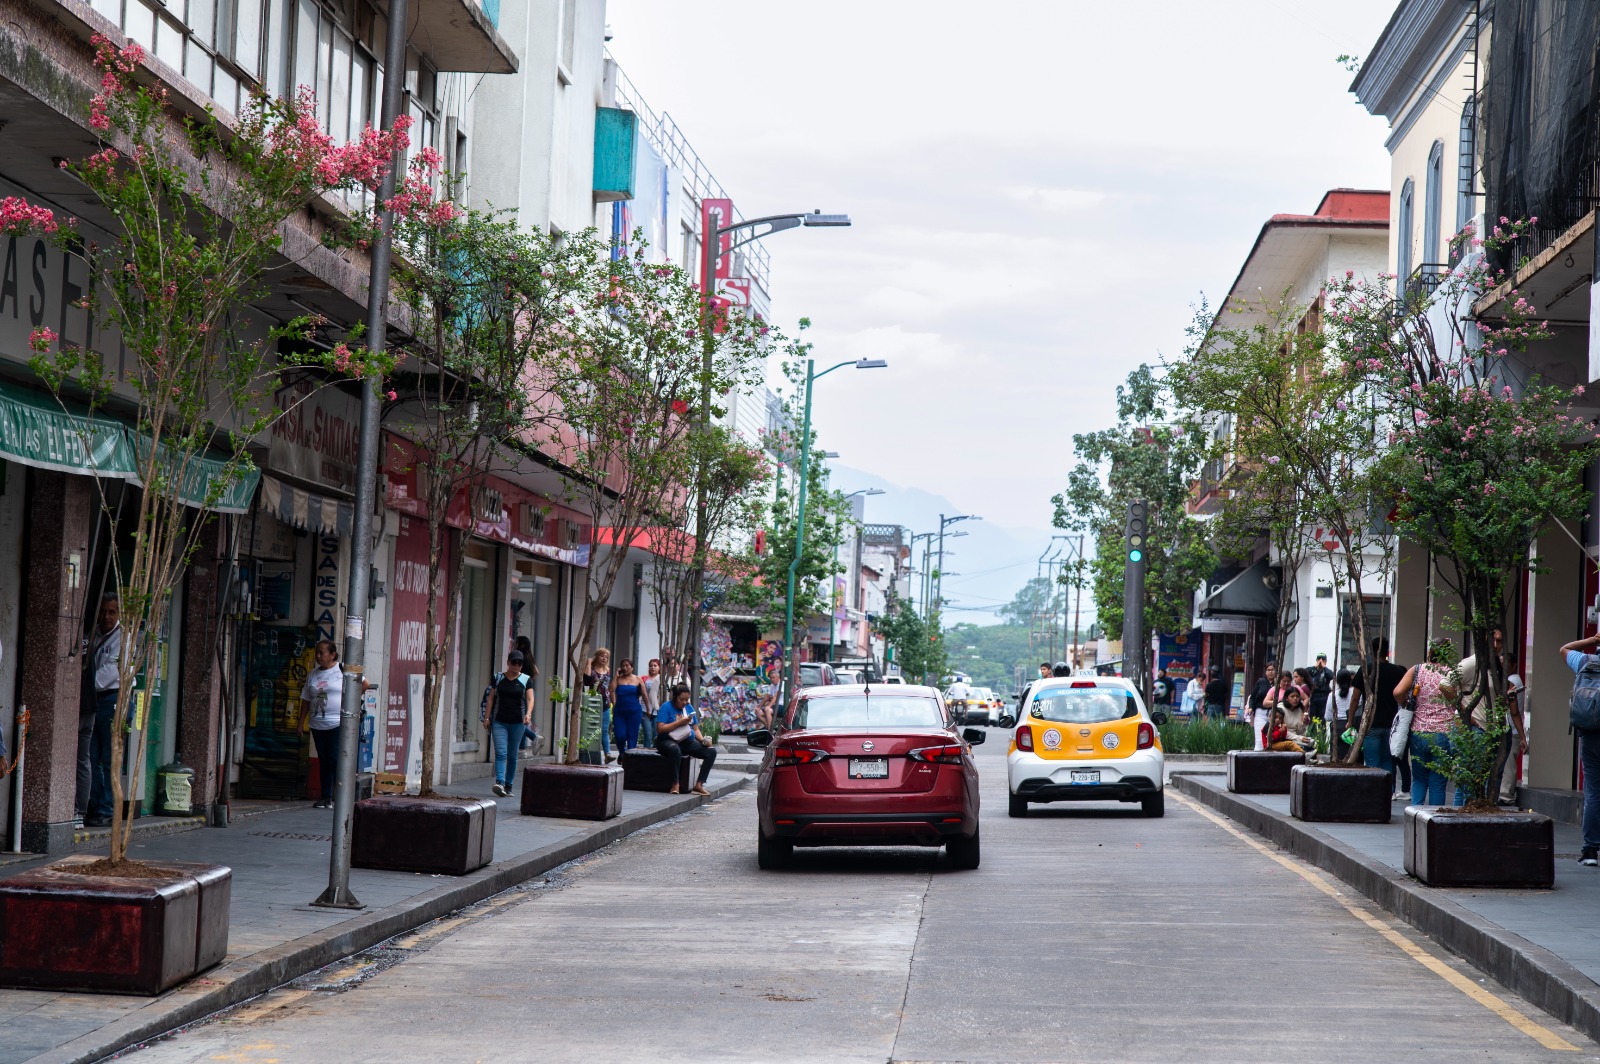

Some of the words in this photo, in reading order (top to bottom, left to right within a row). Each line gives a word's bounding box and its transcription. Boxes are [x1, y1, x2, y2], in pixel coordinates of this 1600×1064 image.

[0, 418, 40, 454] ERIAS
[47, 424, 63, 462] EL
[313, 405, 360, 466] SANTIAG
[318, 535, 339, 571] SA
[316, 576, 336, 587] DE
[315, 589, 336, 643] SAN
